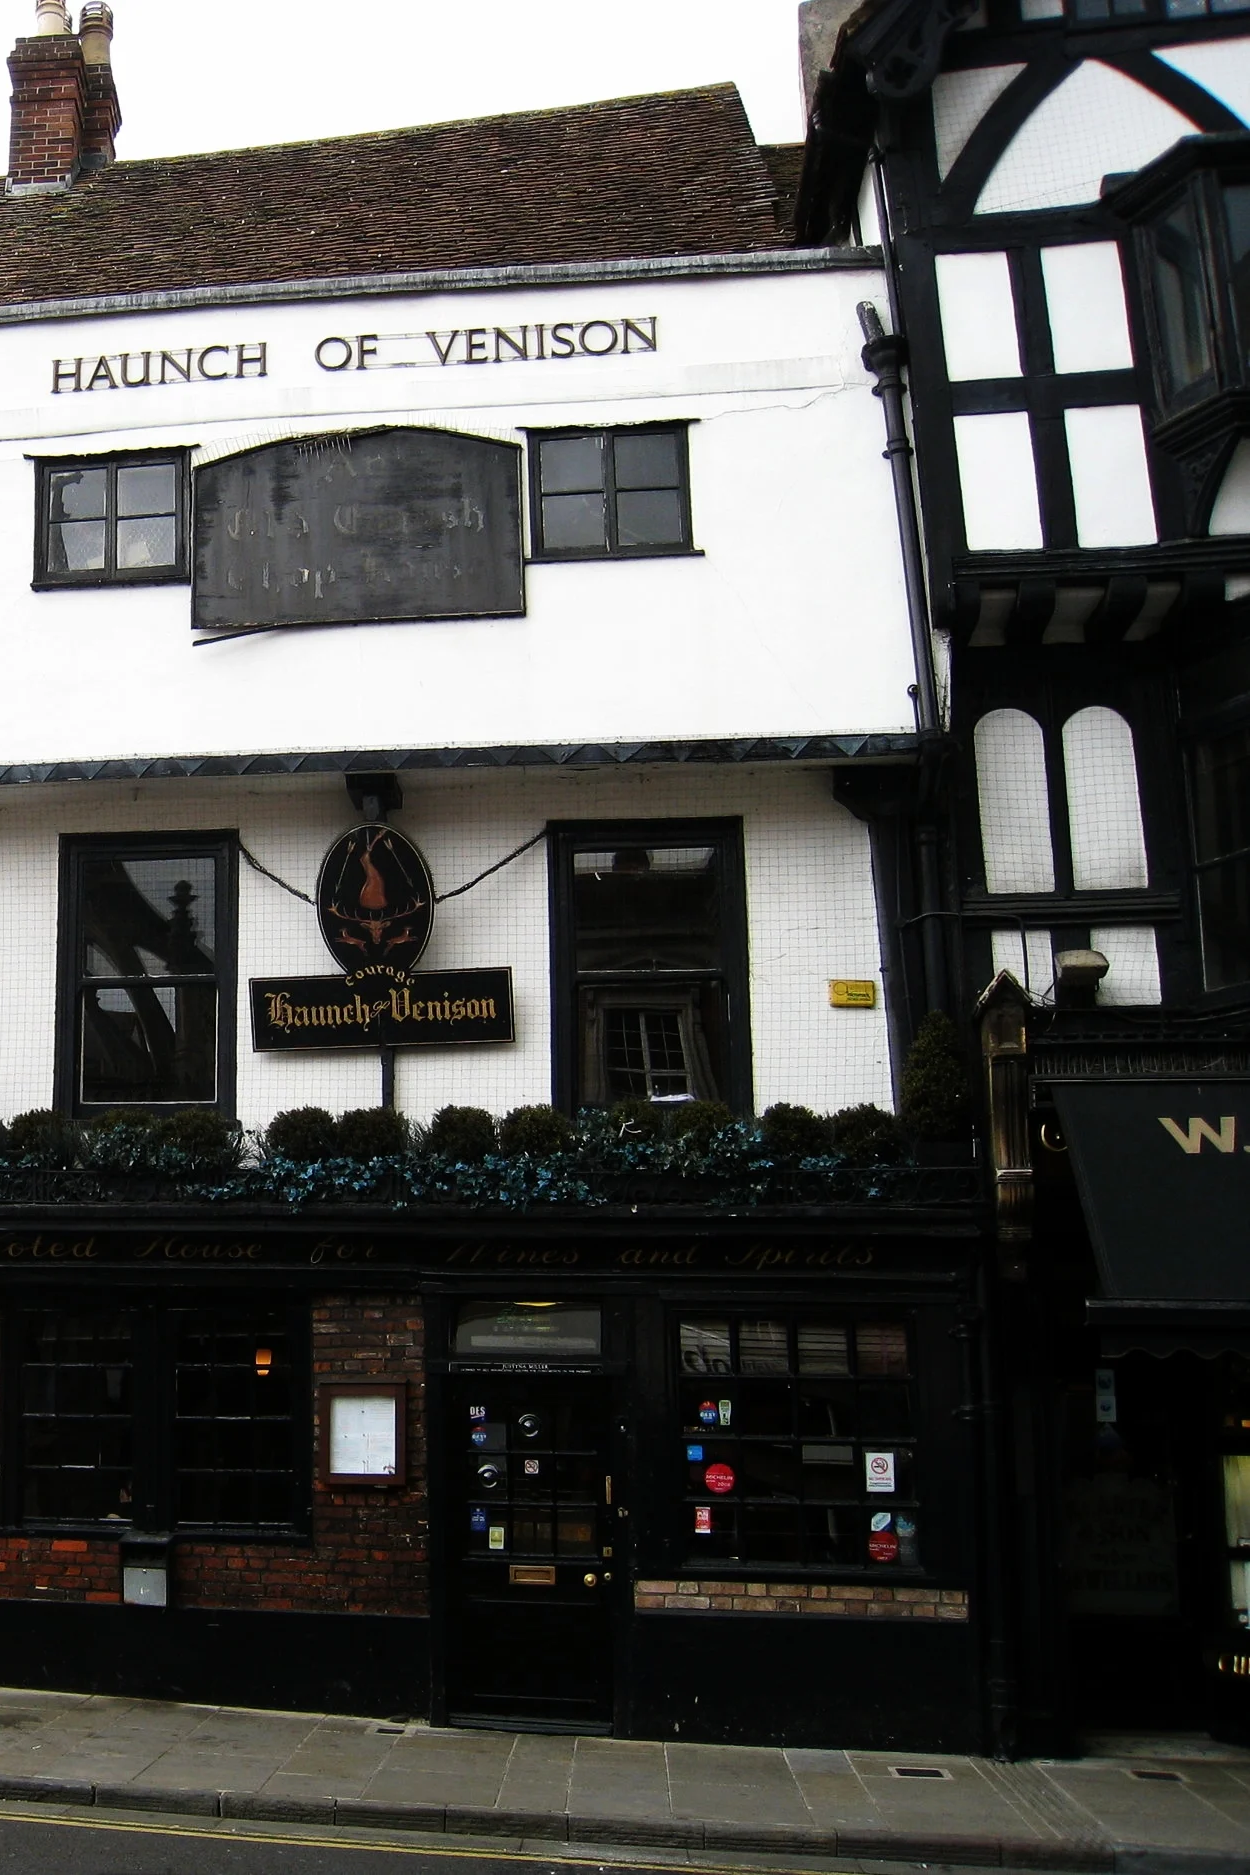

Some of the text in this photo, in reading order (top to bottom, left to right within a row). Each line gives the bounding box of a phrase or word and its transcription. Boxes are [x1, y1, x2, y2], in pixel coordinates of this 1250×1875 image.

[51, 316, 658, 394] HAUNCH OF VENISON
[265, 992, 370, 1034] Haunch
[388, 987, 498, 1025] Venison
[615, 1242, 702, 1266] and
